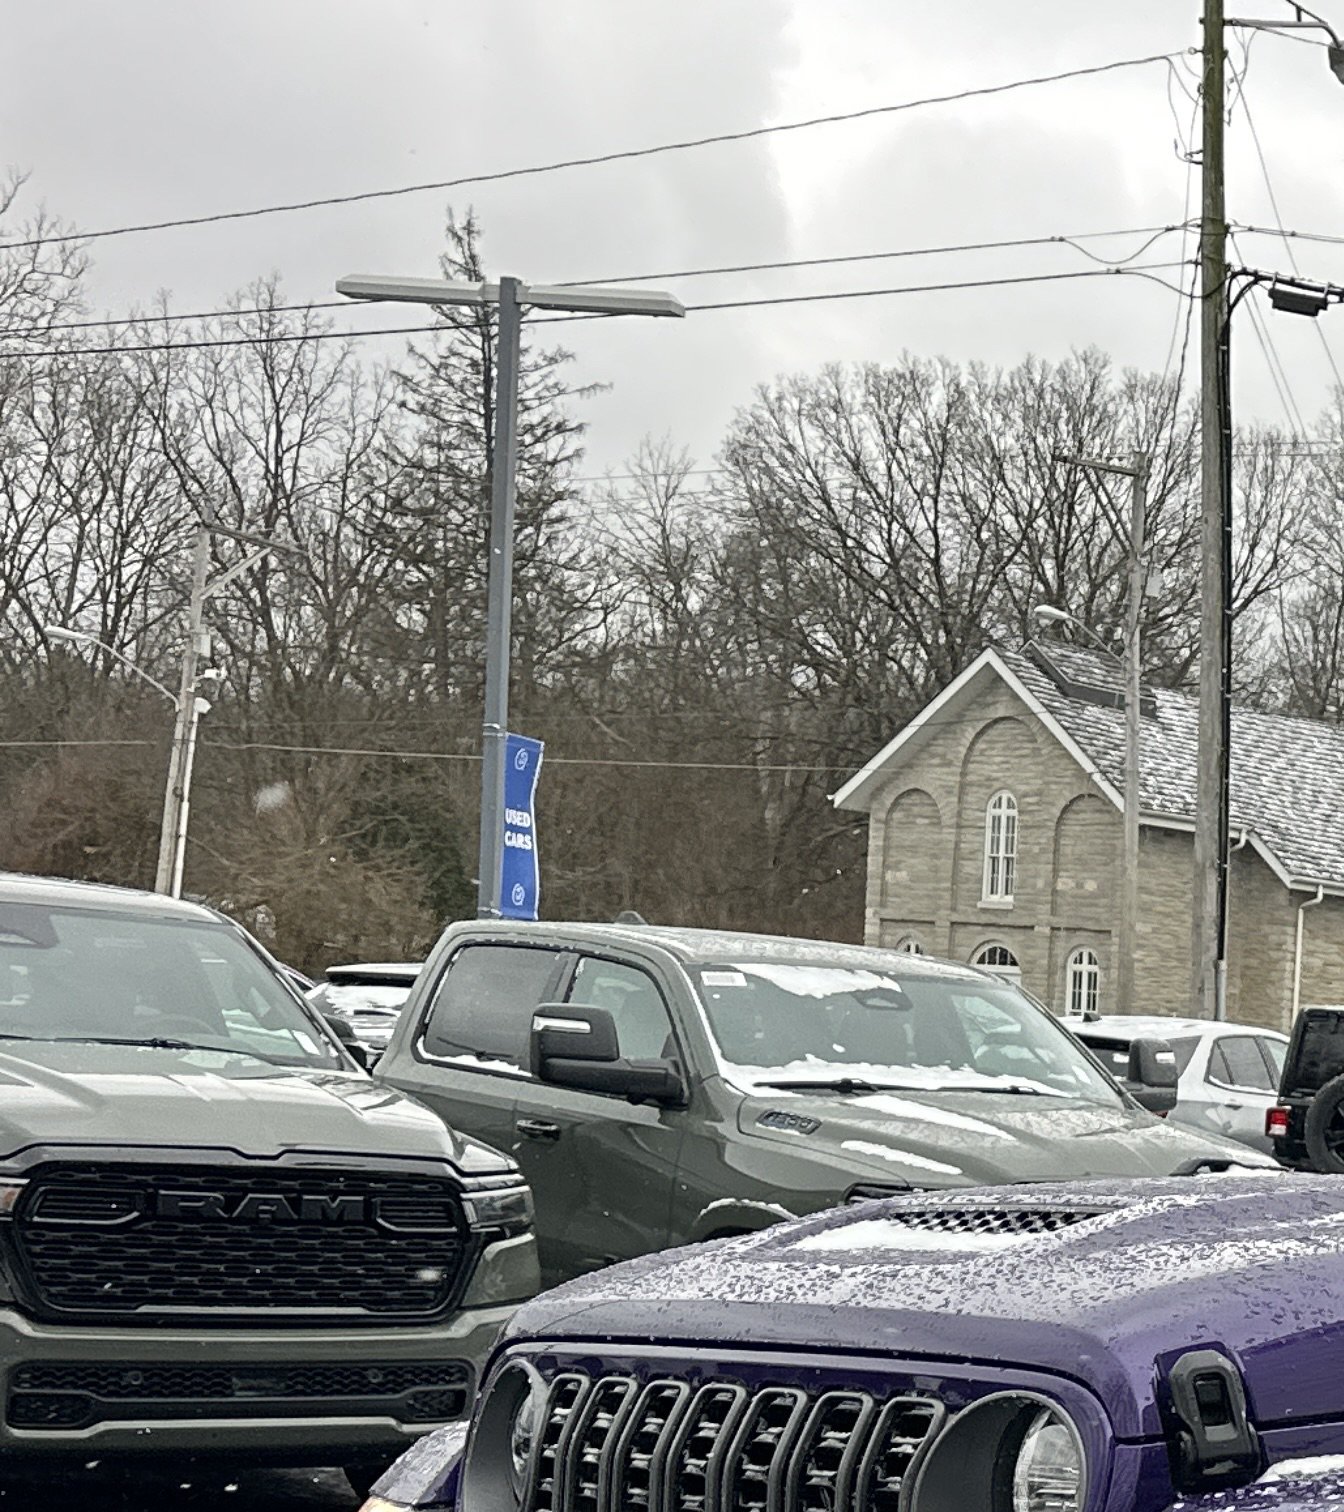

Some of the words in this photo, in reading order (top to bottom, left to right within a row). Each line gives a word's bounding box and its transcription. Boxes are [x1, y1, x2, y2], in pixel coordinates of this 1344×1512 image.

[504, 807, 531, 828] USED
[504, 830, 532, 850] CARS
[157, 1189, 365, 1222] RAM
